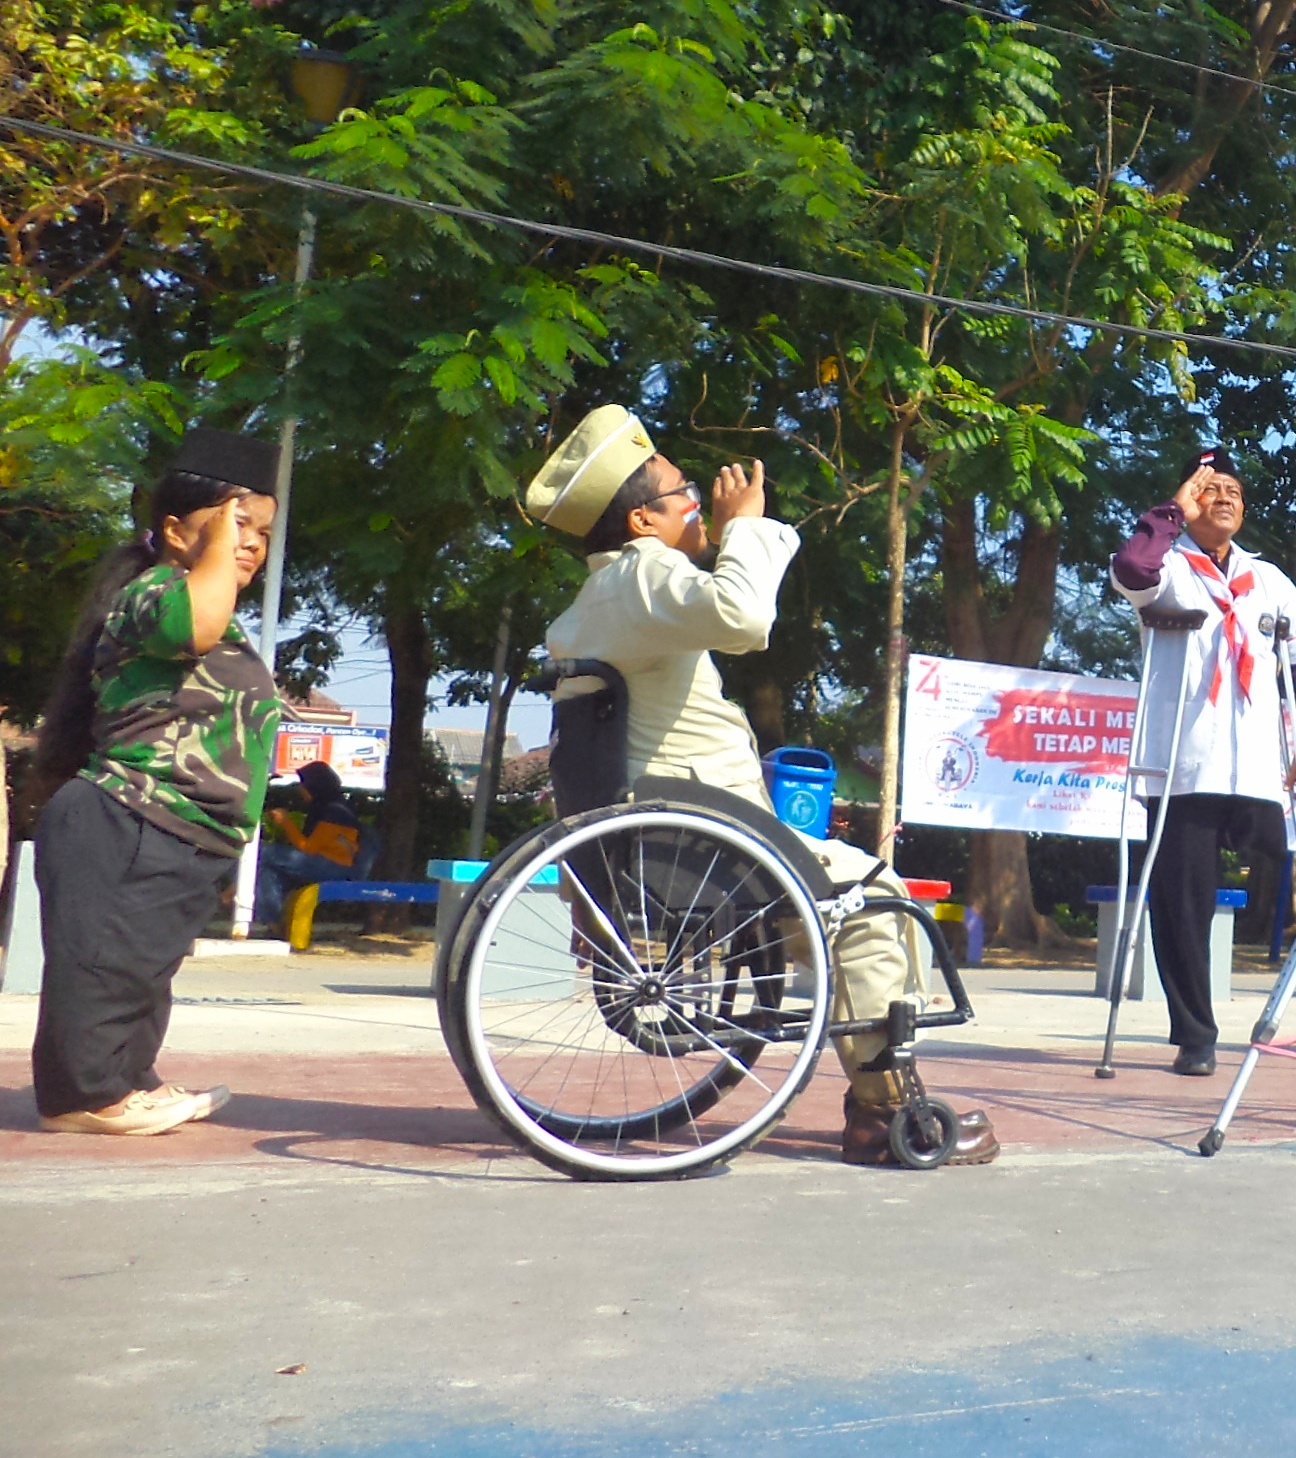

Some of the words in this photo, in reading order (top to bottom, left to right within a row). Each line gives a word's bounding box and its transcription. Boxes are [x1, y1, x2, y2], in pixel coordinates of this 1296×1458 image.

[915, 660, 941, 701] 74
[1012, 704, 1096, 727] SEKALI
[1106, 710, 1136, 729] ME
[1033, 732, 1097, 753] TETAP
[1102, 736, 1130, 755] ME
[1013, 768, 1053, 787] Kerja
[1057, 772, 1091, 789] Kita
